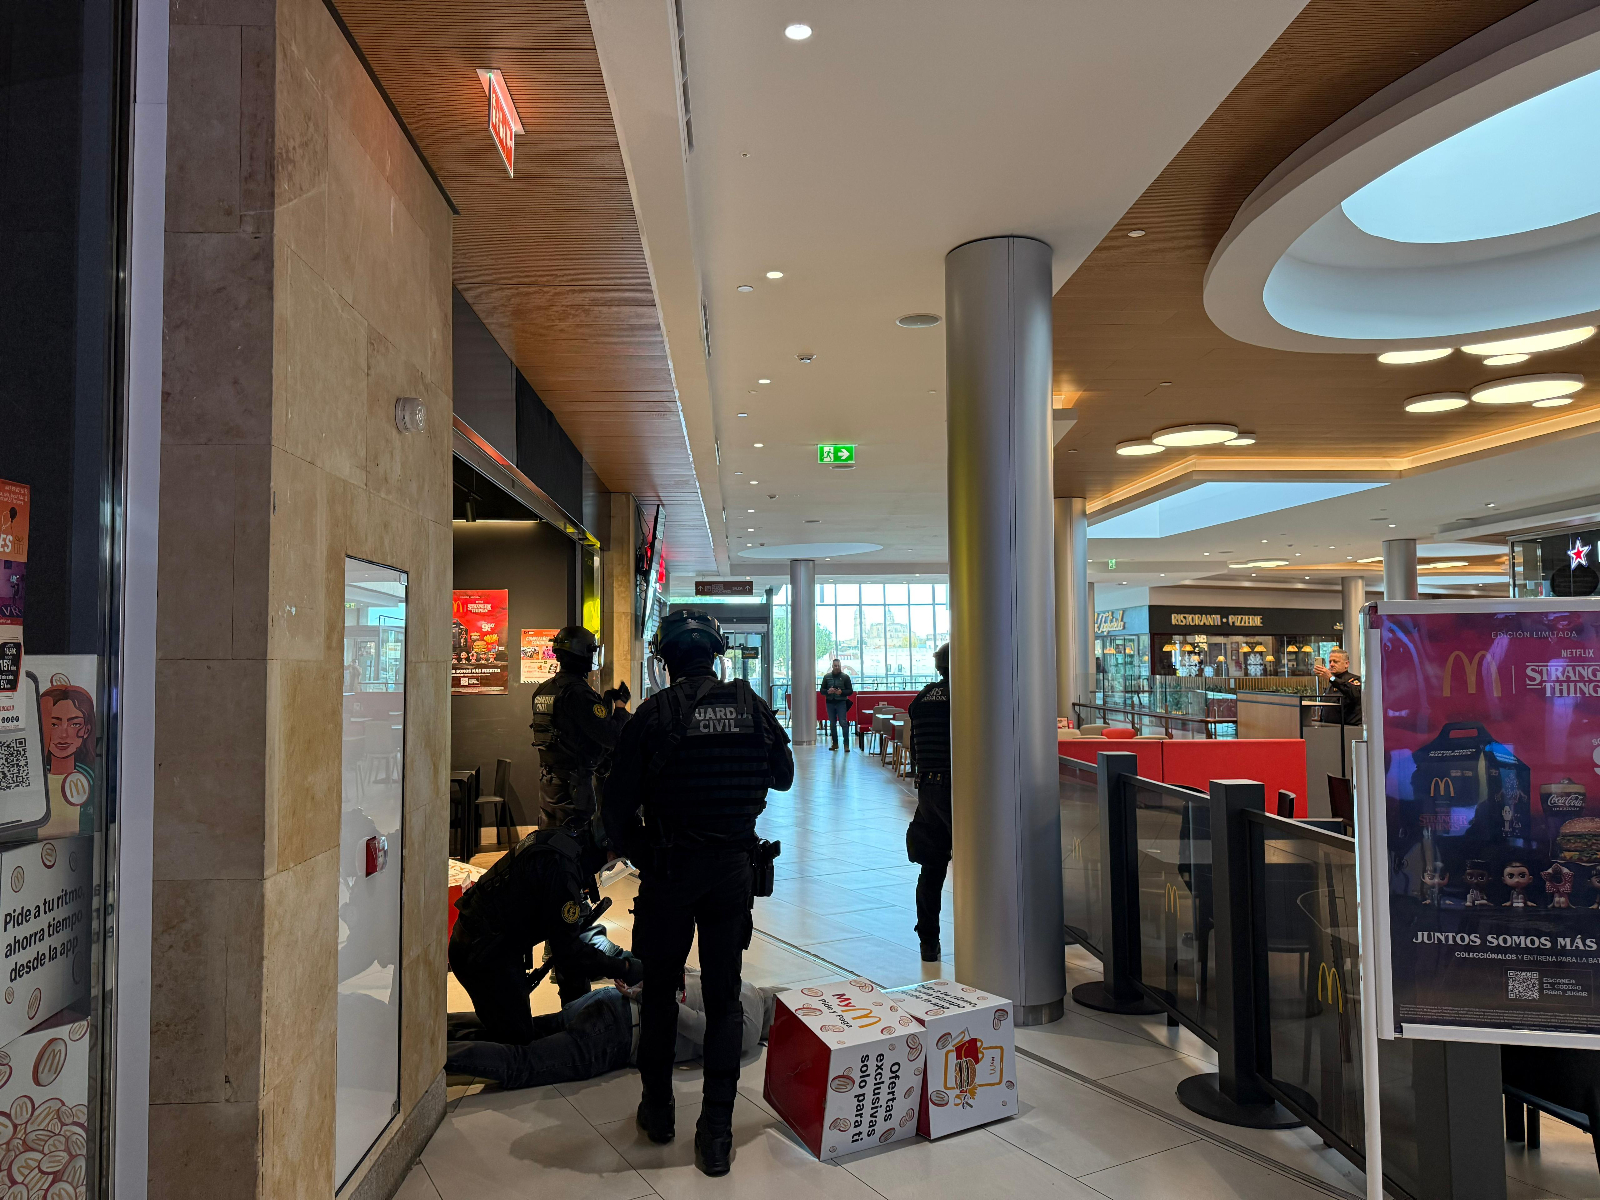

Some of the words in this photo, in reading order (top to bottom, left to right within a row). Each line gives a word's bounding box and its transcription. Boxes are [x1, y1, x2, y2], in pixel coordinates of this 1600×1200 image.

[1171, 613, 1221, 626] RISTORANTI
[1229, 615, 1263, 626] PIZZERIE
[1491, 630, 1530, 639] EDICIÓN
[1533, 630, 1578, 639] LIMITADA
[1561, 648, 1595, 658] NETFLIX
[694, 707, 752, 720] UARD
[699, 719, 740, 733] CIVIL
[1419, 813, 1468, 826] STRANGER
[4, 906, 31, 932] Pide
[33, 905, 42, 921] a
[42, 897, 55, 916] tu
[5, 928, 45, 959] ahorra
[46, 909, 83, 938] tiempo
[1413, 931, 1482, 946] JUNTOS
[1486, 934, 1552, 949] SOMOS
[1557, 935, 1598, 951] MÁS
[9, 950, 46, 984] desde
[48, 944, 58, 963] la
[59, 935, 79, 958] app
[1455, 951, 1516, 960] COLECCIÓNALOS
[1524, 954, 1556, 962] ENTRENA
[859, 1053, 871, 1091] solo
[866, 1052, 885, 1137] exclusivas
[883, 1060, 901, 1123] Ofertas
[853, 1092, 868, 1129] para
[850, 1131, 863, 1144] ti
